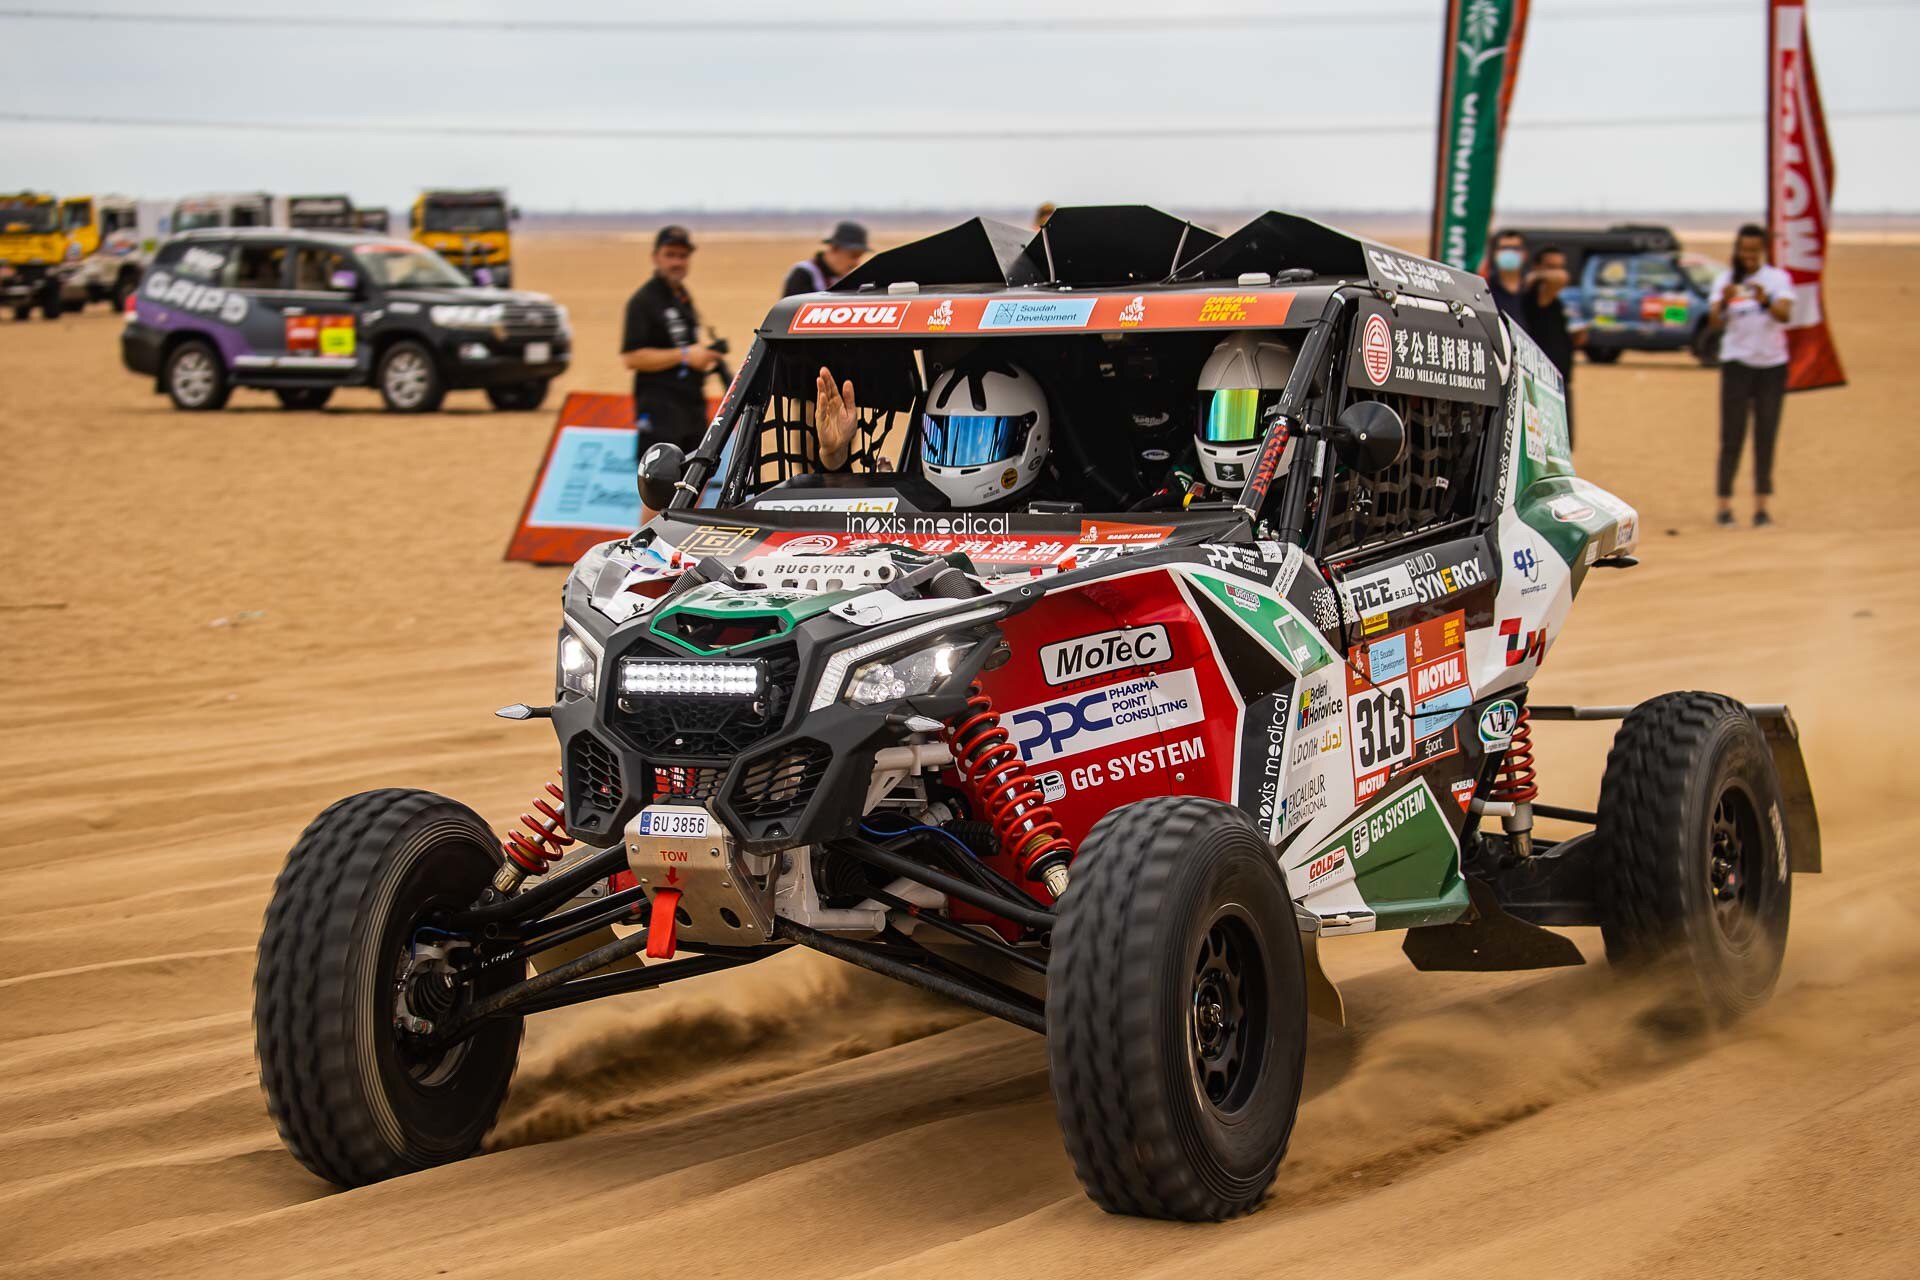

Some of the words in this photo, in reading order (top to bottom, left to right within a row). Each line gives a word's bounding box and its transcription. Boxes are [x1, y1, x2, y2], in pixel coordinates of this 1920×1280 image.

[801, 306, 898, 324] MOTUL
[1015, 312, 1077, 322] Development
[1019, 304, 1057, 312] Soudah
[1395, 365, 1415, 381] ZERO
[1416, 369, 1448, 385] MILEAGE
[1449, 373, 1486, 390] LUBRICANT
[846, 512, 906, 534] inoxis
[913, 513, 1009, 535] medical
[774, 564, 855, 574] BUGGYRA
[1199, 543, 1244, 570] PPC
[1404, 552, 1437, 577] BUILD
[1350, 577, 1394, 611] BCE
[1056, 632, 1157, 678] MoTeC
[1417, 657, 1461, 696] MOTUL
[1109, 680, 1159, 700] PHARMA
[1112, 695, 1148, 713] POINT
[1115, 699, 1188, 725] CONSULTING
[1012, 691, 1114, 761] PPC
[1357, 686, 1406, 768] 313
[1487, 703, 1513, 732] VAF
[1264, 692, 1289, 777] medical
[1070, 764, 1104, 791] GC
[1107, 736, 1206, 781] SYSTEM
[1288, 773, 1326, 814] EXCALIBUR
[1359, 773, 1386, 797] MOTUL
[653, 816, 670, 832] 6U
[672, 816, 705, 834] 3856
[1288, 795, 1327, 830] INTERNATIONAL
[1370, 814, 1385, 843] GC
[1385, 788, 1427, 833] SYSTEM
[660, 850, 688, 862] TOW
[1309, 854, 1333, 880] GOLD
